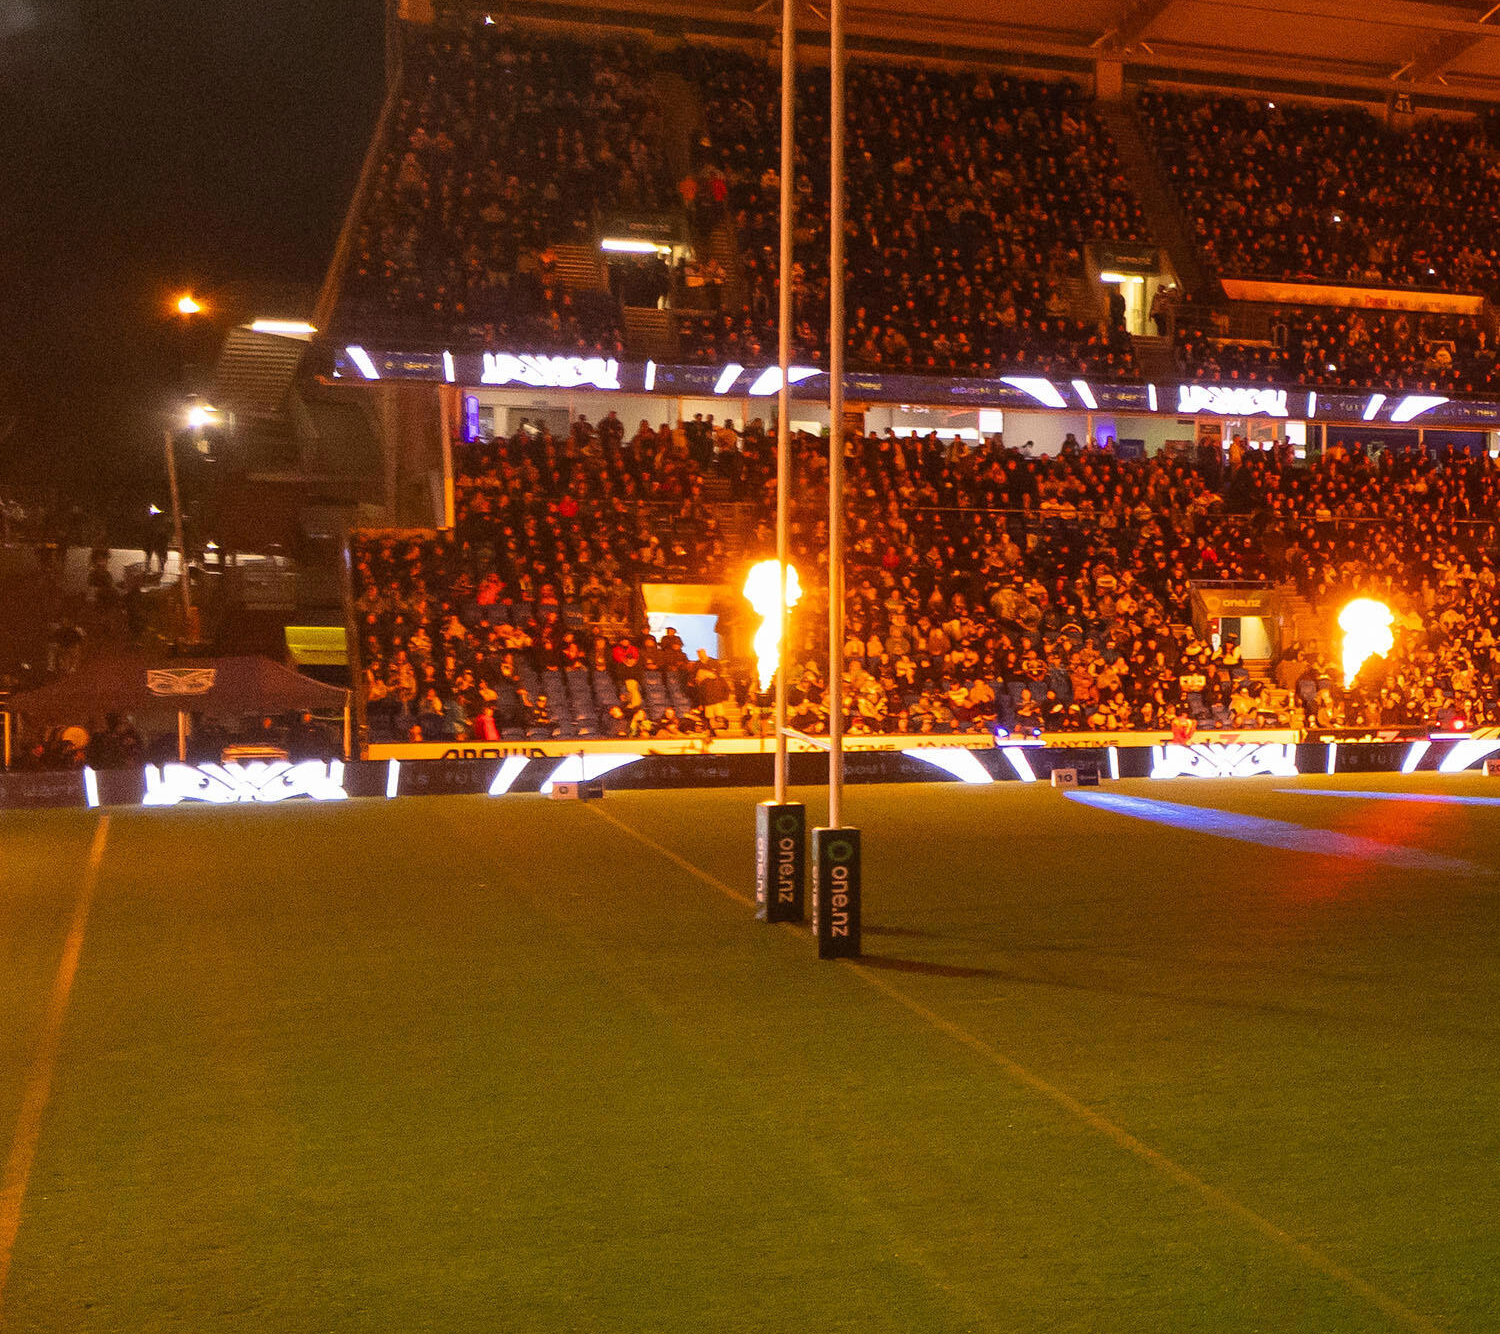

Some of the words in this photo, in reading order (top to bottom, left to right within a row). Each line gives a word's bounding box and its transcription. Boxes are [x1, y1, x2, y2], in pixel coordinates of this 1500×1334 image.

[1222, 598, 1261, 608] one.nz
[1055, 773, 1074, 783] 10
[777, 836, 796, 905] one.nz
[831, 864, 849, 939] one.nz
